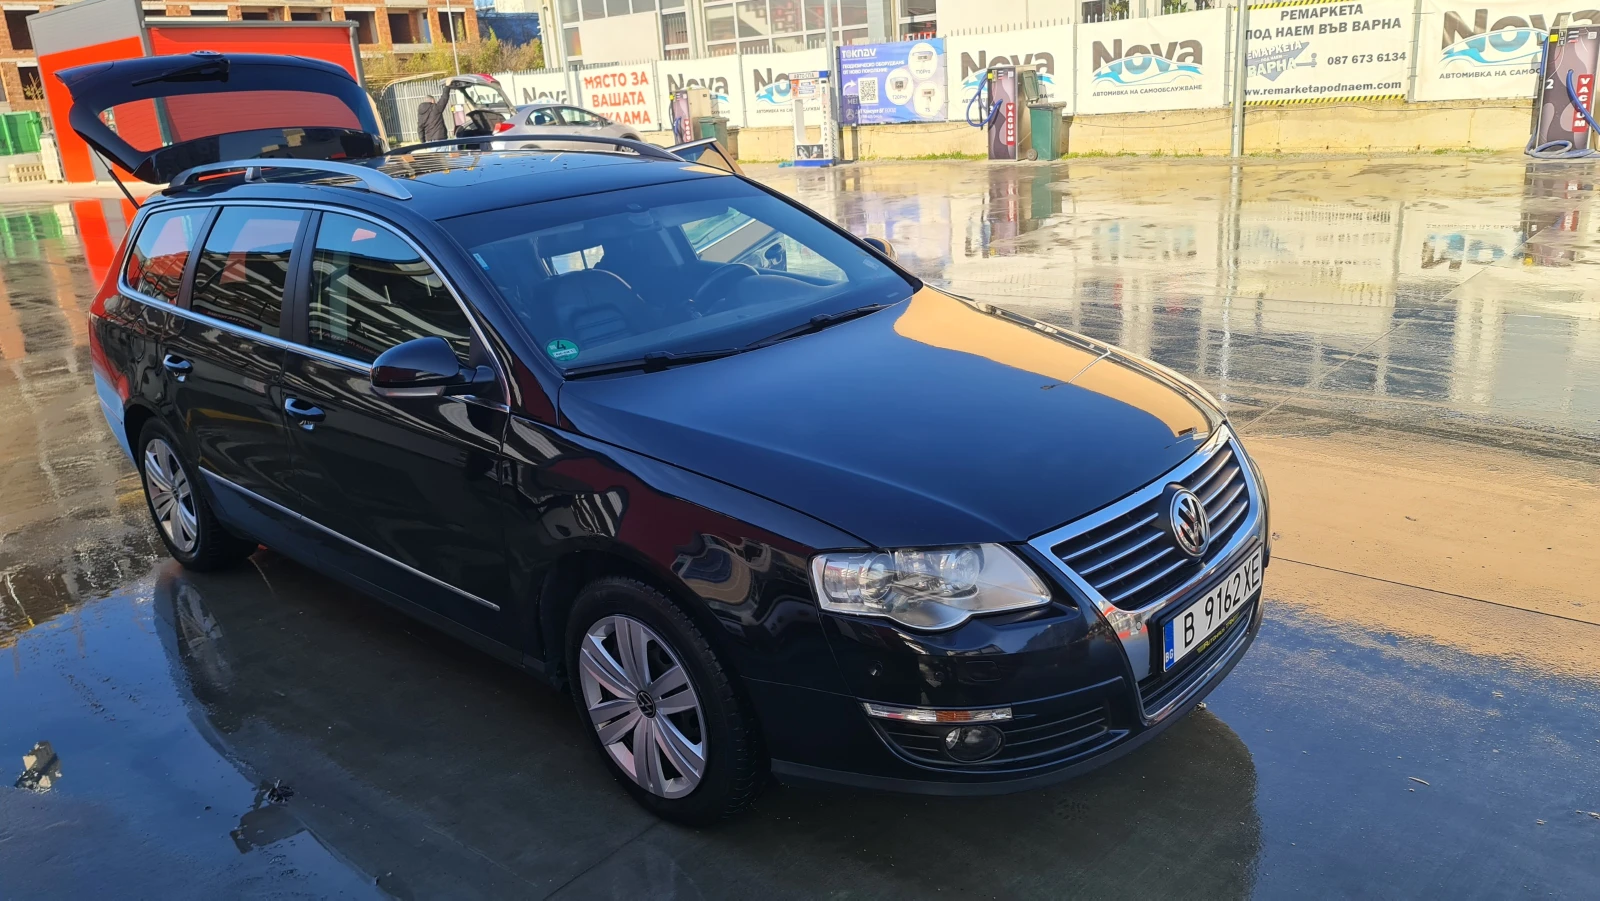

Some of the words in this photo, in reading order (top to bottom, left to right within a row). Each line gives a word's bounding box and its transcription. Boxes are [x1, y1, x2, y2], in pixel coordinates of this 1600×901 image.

[1280, 4, 1363, 21] РЕМАРКЕТА
[1245, 29, 1272, 41] ПОД
[1275, 24, 1314, 38] НАЕМ
[1318, 22, 1348, 35] ВЪВ
[1352, 17, 1402, 32] ВАРНА
[1092, 38, 1203, 78] Nova
[1247, 40, 1303, 60] ЕМАРКЕТА
[1327, 55, 1348, 66] 087
[1352, 53, 1374, 64] 673
[1377, 51, 1407, 63] 6134
[1247, 57, 1297, 78] ВАРНА
[1439, 70, 1491, 79] АВТОМИВКА
[584, 72, 627, 90] МЯСТО
[630, 71, 649, 86] ЗА
[1244, 81, 1402, 96] ww.remarketapodnaem.com
[1545, 79, 1554, 90] 2
[1092, 88, 1128, 97] АВТОМИВКА
[1140, 84, 1202, 94] САМООБСЛУЖВАНЕ
[592, 91, 646, 108] ВАШАТА
[1006, 104, 1014, 142] VACUUM
[556, 340, 566, 350] 4
[1183, 611, 1195, 649] B
[1205, 572, 1241, 631] 9162
[1243, 553, 1260, 597] XE
[1165, 648, 1174, 663] BG
